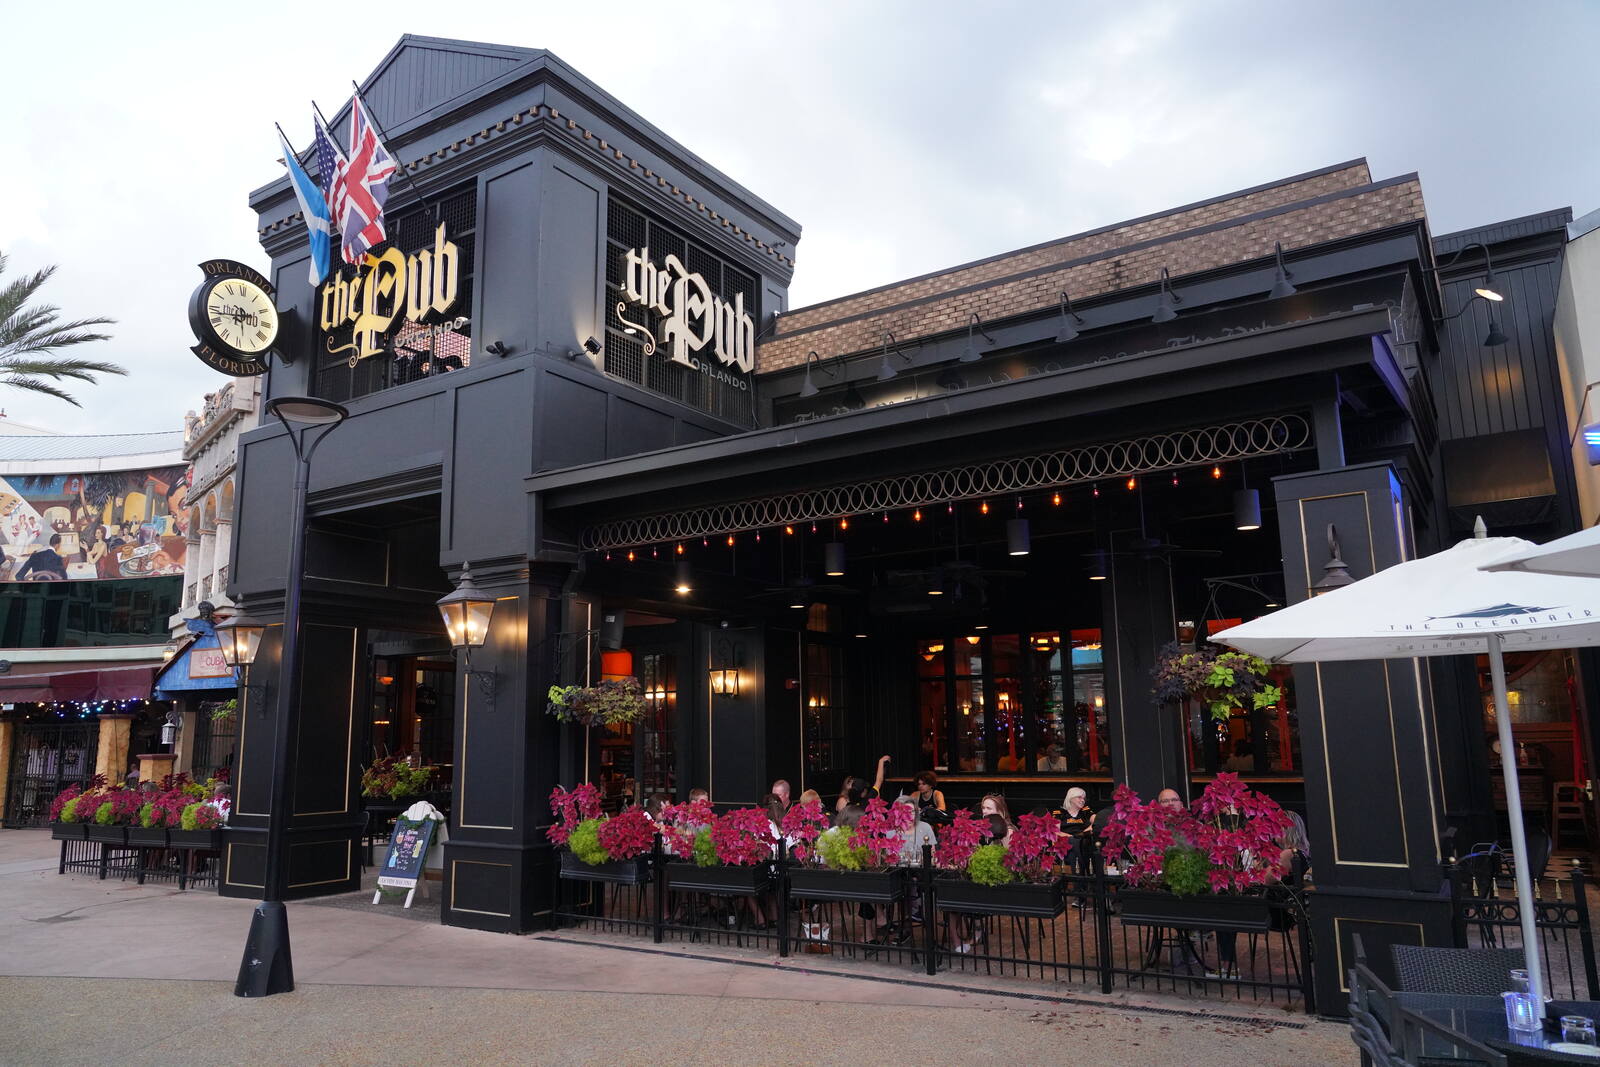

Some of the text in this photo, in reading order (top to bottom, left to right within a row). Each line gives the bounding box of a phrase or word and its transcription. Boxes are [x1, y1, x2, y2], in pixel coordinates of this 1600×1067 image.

[206, 262, 271, 294] ORLANDO
[321, 221, 458, 369] the Pub
[625, 246, 754, 374] the Pub
[394, 317, 464, 348] ORLANDO
[201, 345, 265, 374] FLORIDA
[691, 356, 748, 392] ORLANDO
[1389, 608, 1594, 632] THE OCEANAIR
